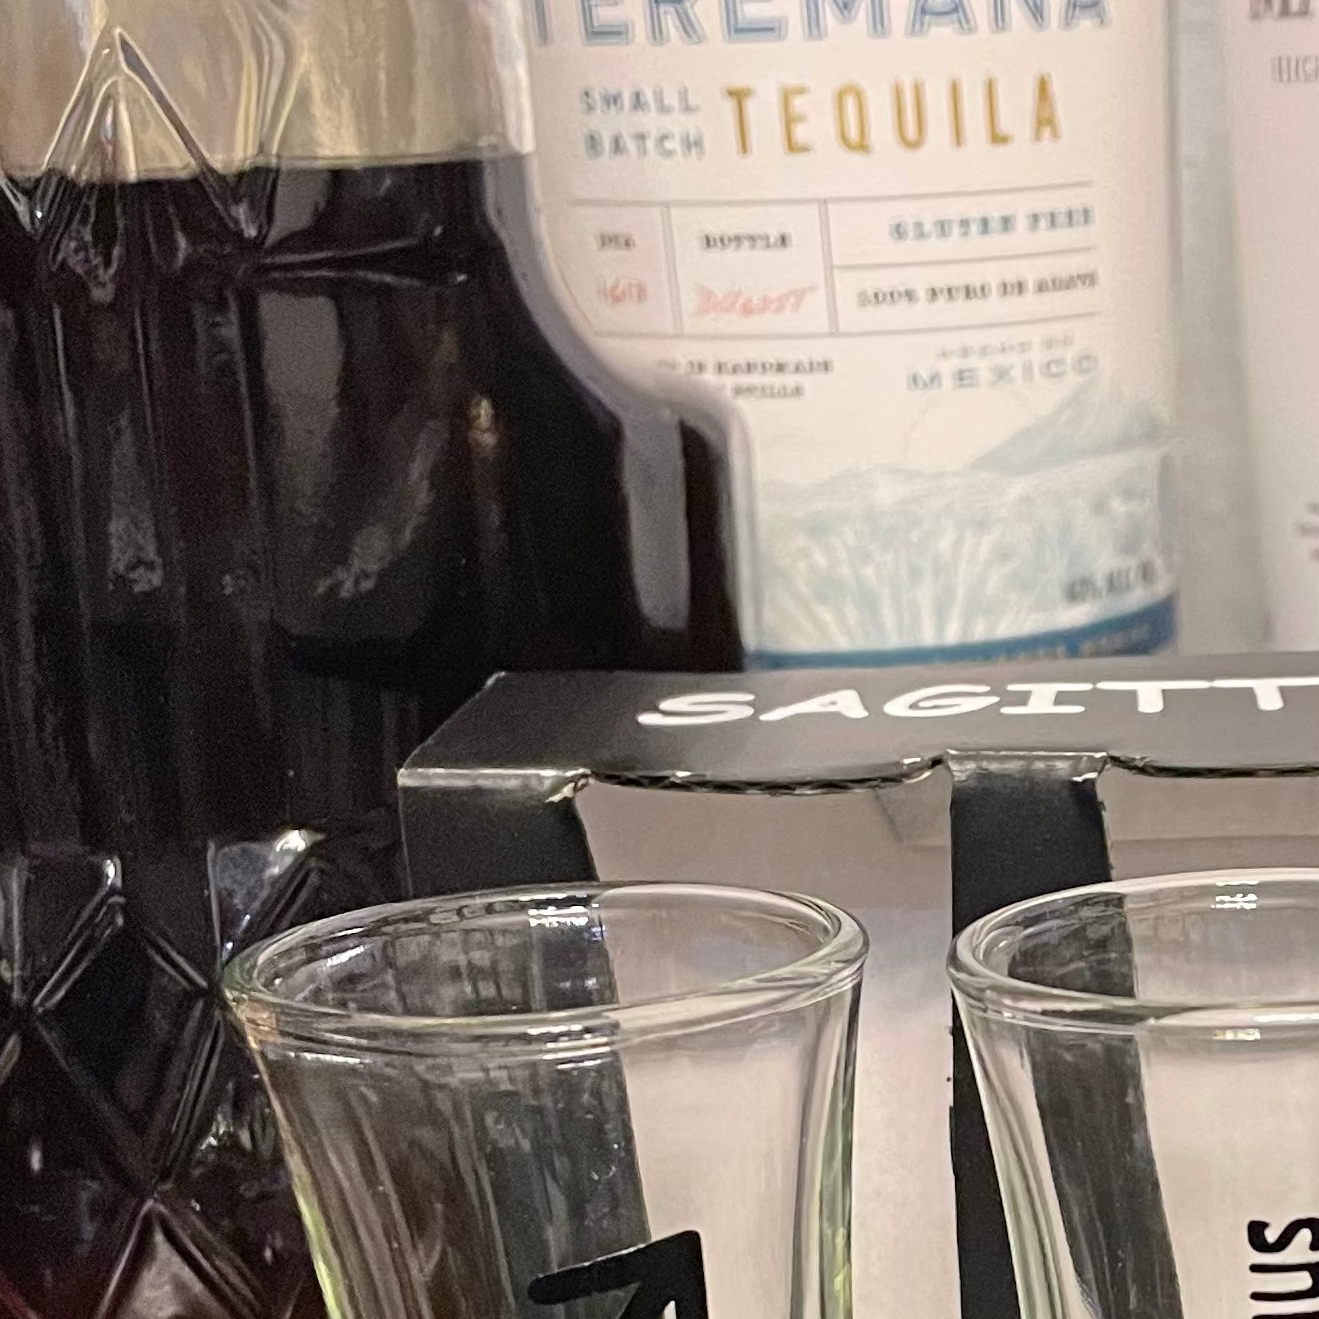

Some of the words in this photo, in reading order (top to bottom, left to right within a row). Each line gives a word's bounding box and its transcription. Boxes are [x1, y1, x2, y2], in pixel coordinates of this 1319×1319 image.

[580, 85, 700, 115] SMALL
[722, 71, 1062, 157] TEQUILA
[582, 130, 706, 160] BATCH
[907, 354, 1100, 392] MEXICO
